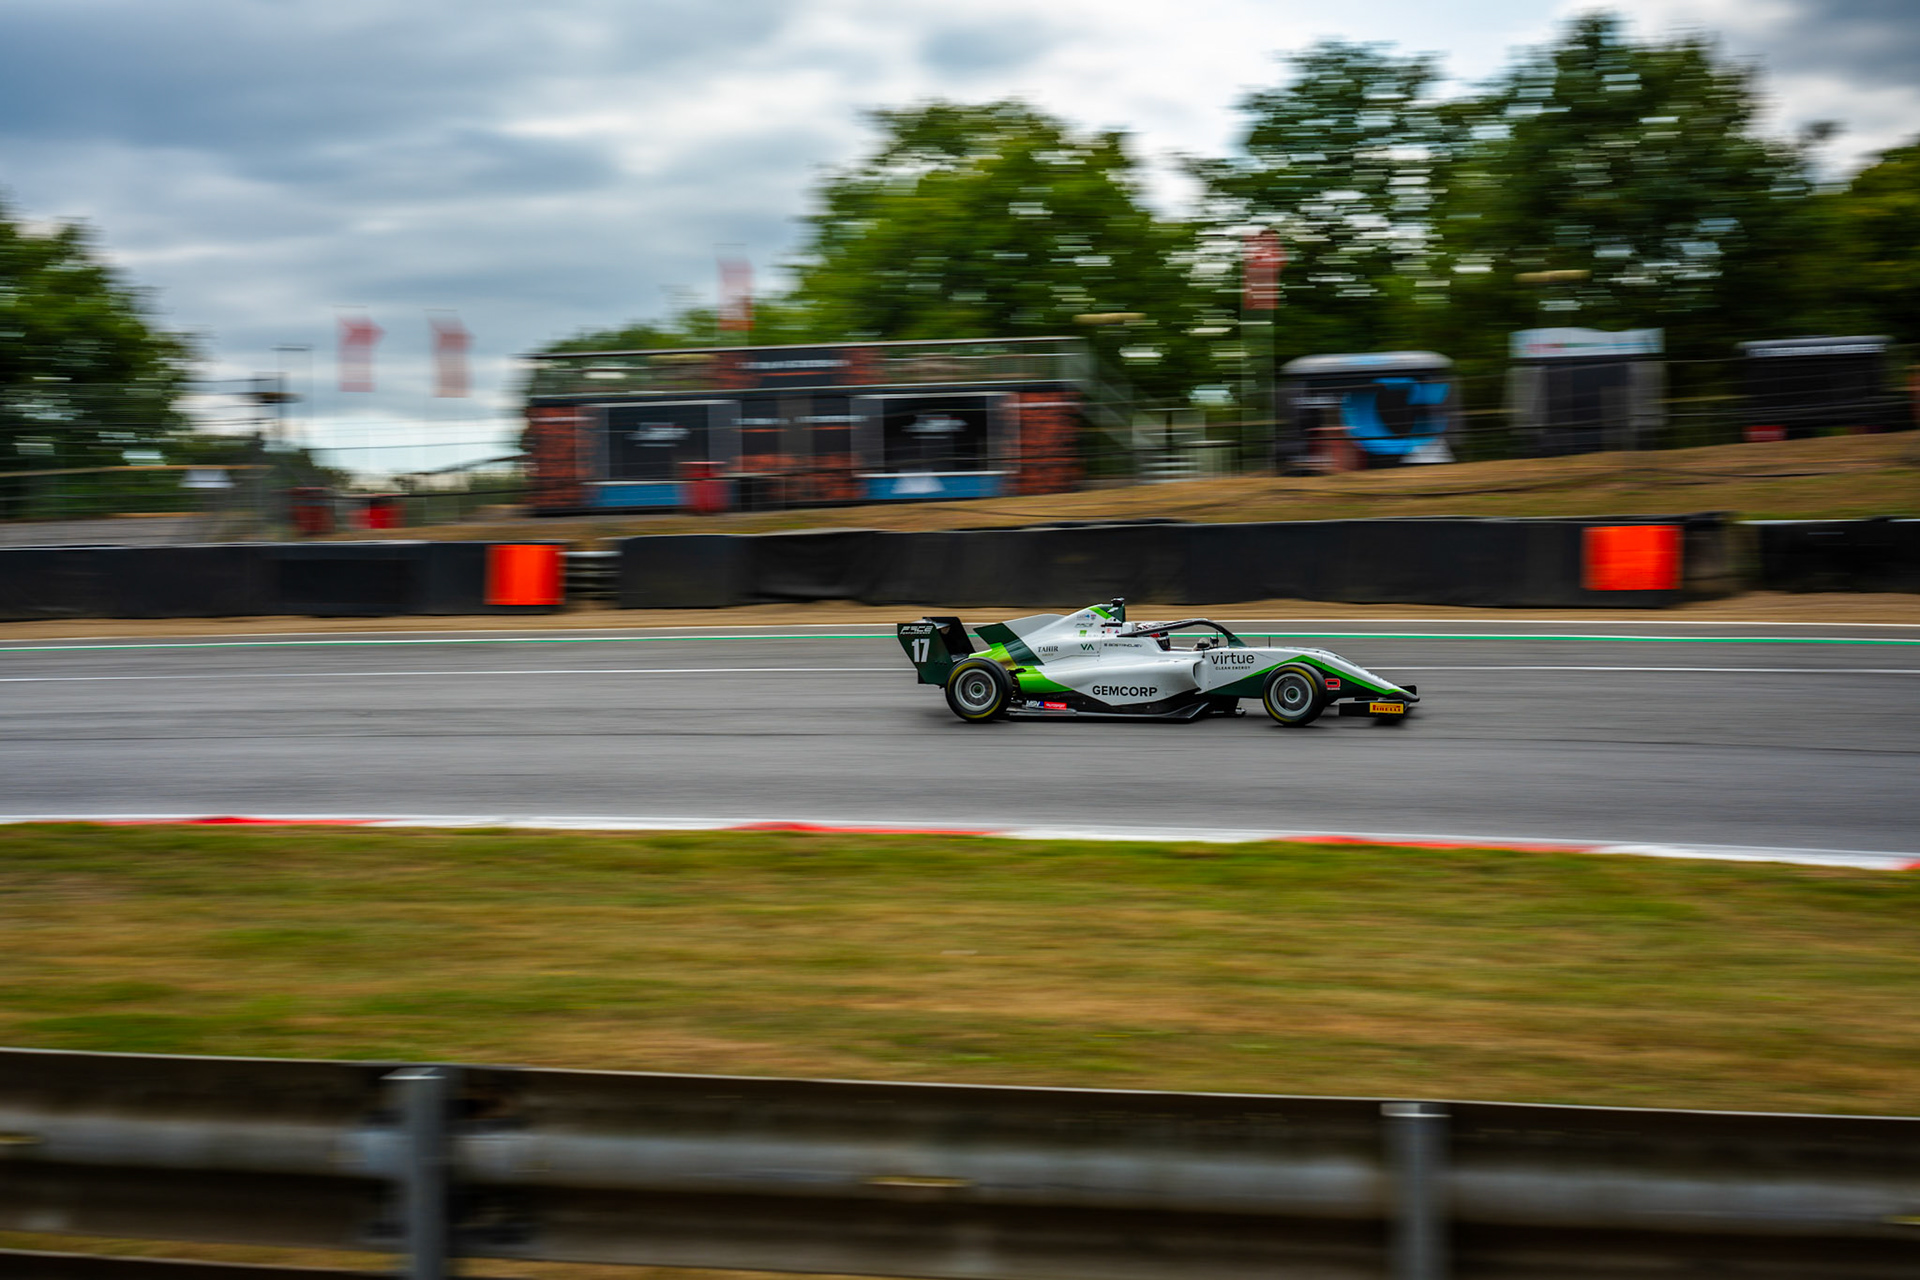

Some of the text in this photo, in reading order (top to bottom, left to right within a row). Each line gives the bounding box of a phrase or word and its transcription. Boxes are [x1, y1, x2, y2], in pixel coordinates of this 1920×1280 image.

[911, 638, 930, 663] 17
[1211, 651, 1255, 665] virtue
[1092, 685, 1158, 697] GEMCORP
